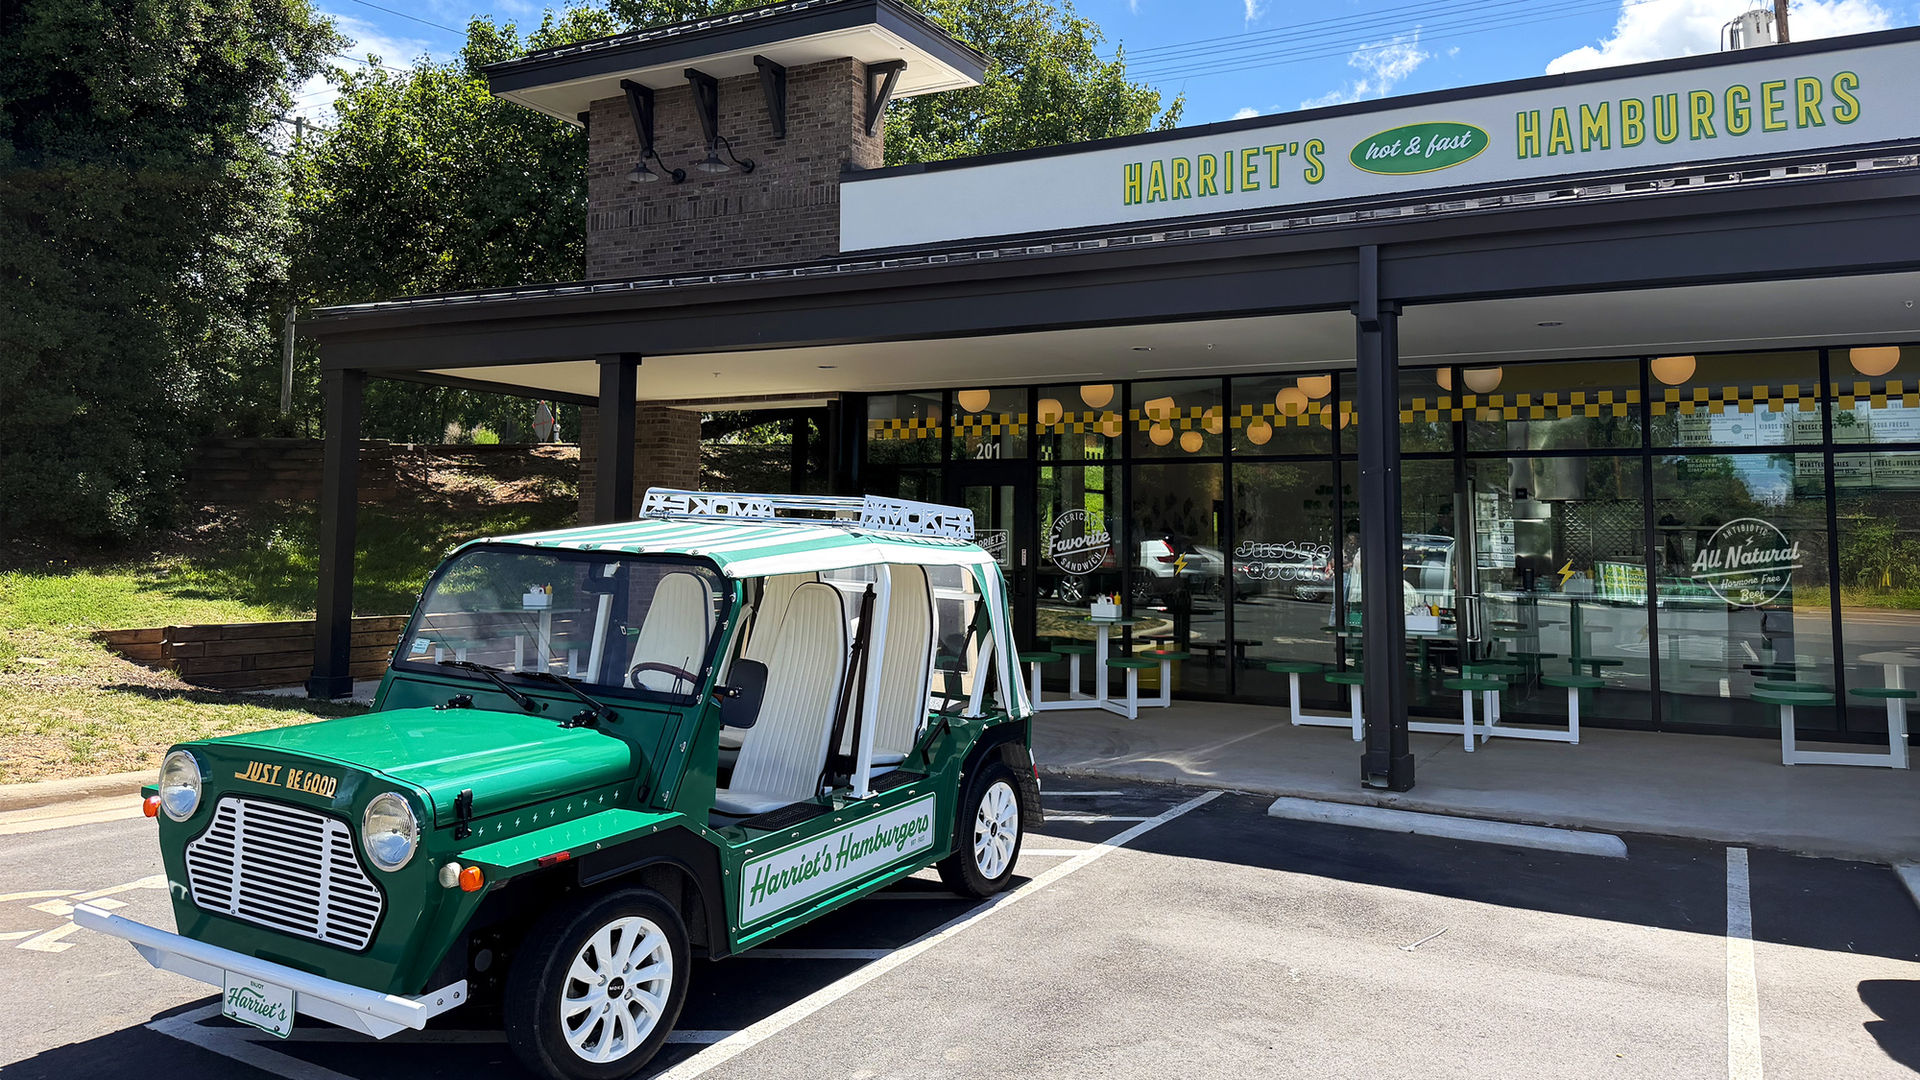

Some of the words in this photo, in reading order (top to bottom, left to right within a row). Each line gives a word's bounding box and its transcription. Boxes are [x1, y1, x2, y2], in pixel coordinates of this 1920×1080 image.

[1516, 70, 1862, 159] HAMBURGERS
[1364, 132, 1402, 160] hot
[1403, 136, 1421, 160] &
[1424, 128, 1473, 160] fast
[1122, 137, 1326, 206] HARRIET'S
[976, 442, 1001, 460] 201
[1047, 530, 1111, 557] Favorite
[1235, 540, 1296, 559] Just
[1298, 541, 1332, 559] Be
[1691, 548, 1722, 573] All
[1724, 541, 1801, 569] Natural
[1060, 551, 1102, 572] SANDWICH
[1720, 576, 1759, 590] Hormone
[1761, 573, 1782, 585] Free
[1739, 586, 1766, 602] Beef
[234, 760, 282, 786] JUST
[286, 768, 304, 791] BE
[303, 771, 338, 799] GOOD
[749, 843, 833, 907] Harriet's
[834, 813, 930, 872] Hamburgers
[250, 980, 265, 990] ENJOY
[227, 986, 288, 1022] Harriet's
